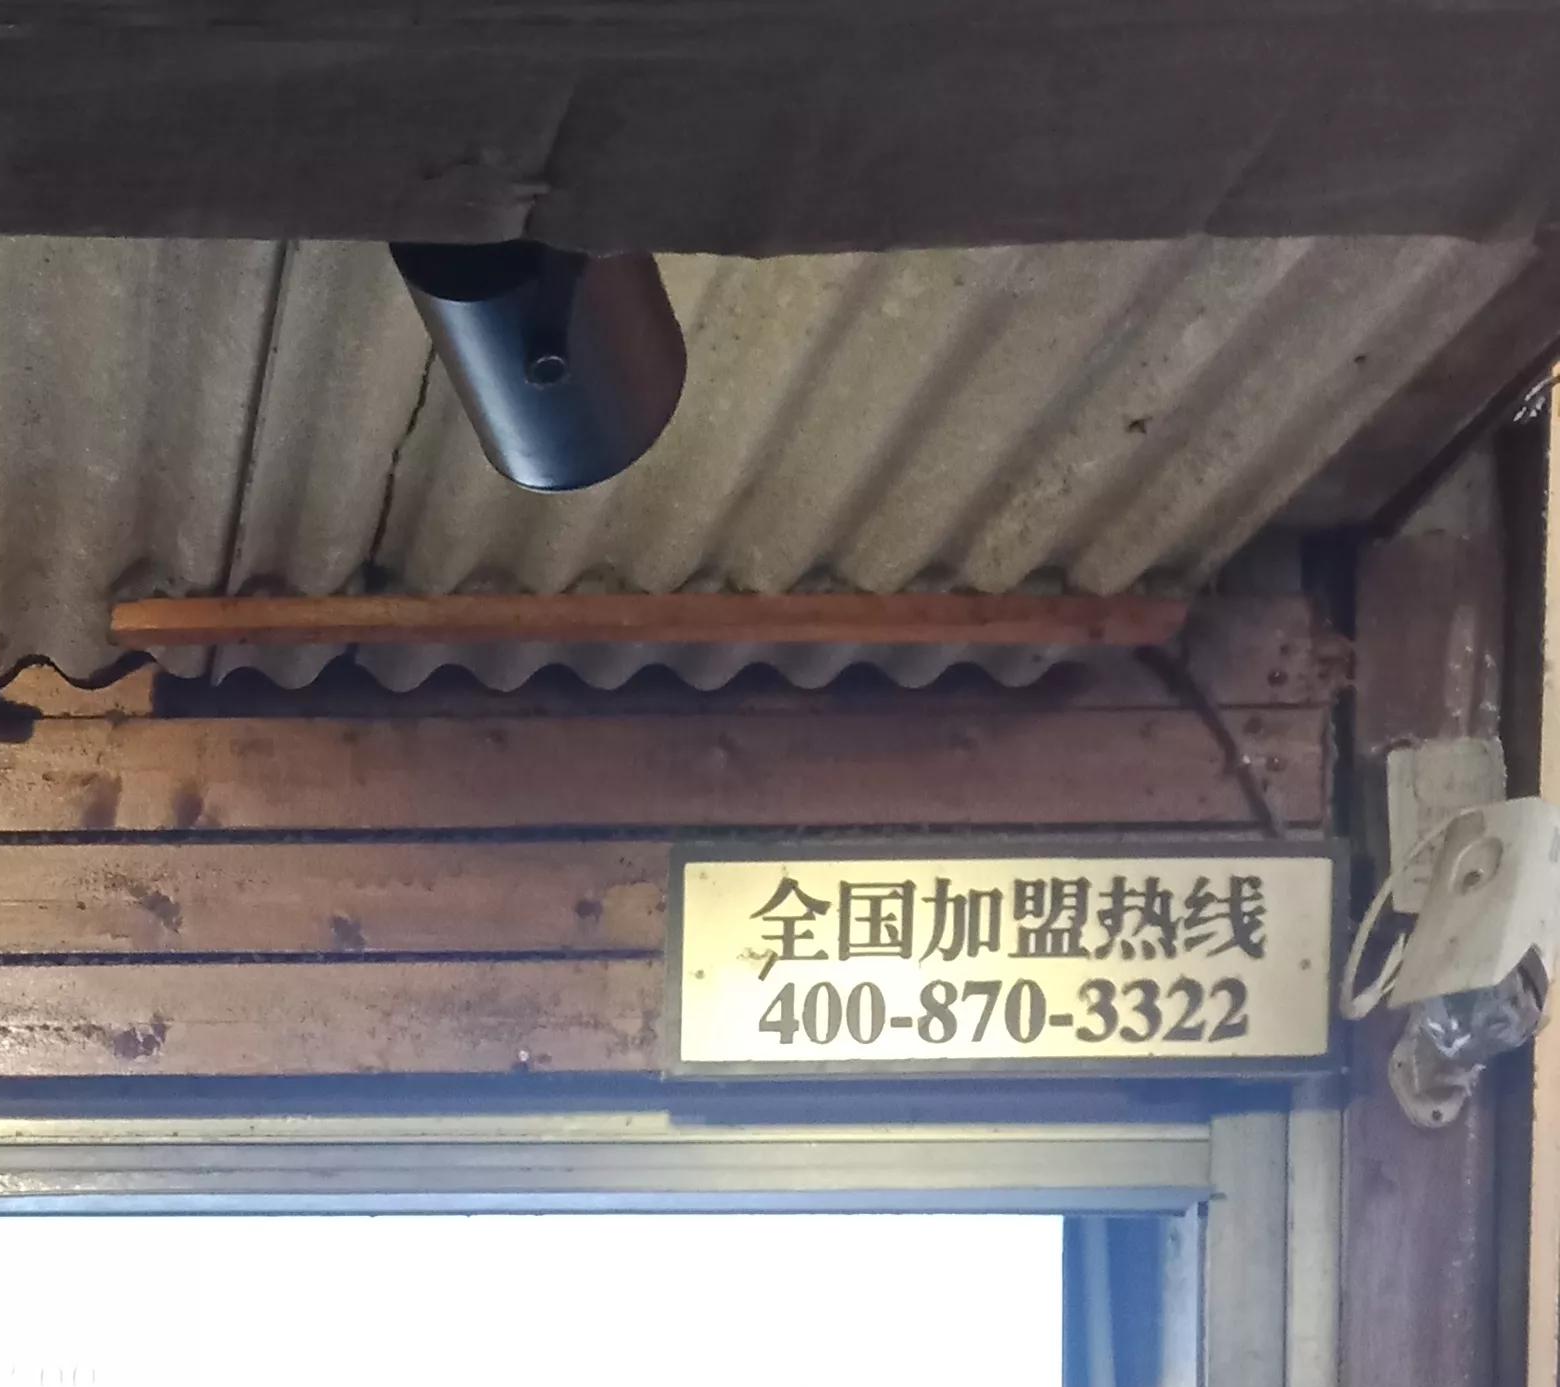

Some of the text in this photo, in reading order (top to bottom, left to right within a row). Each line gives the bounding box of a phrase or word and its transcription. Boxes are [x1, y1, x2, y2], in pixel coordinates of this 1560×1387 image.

[750, 875, 1267, 962] 全国加盟热线
[759, 976, 1250, 1045] 400-870-3322
